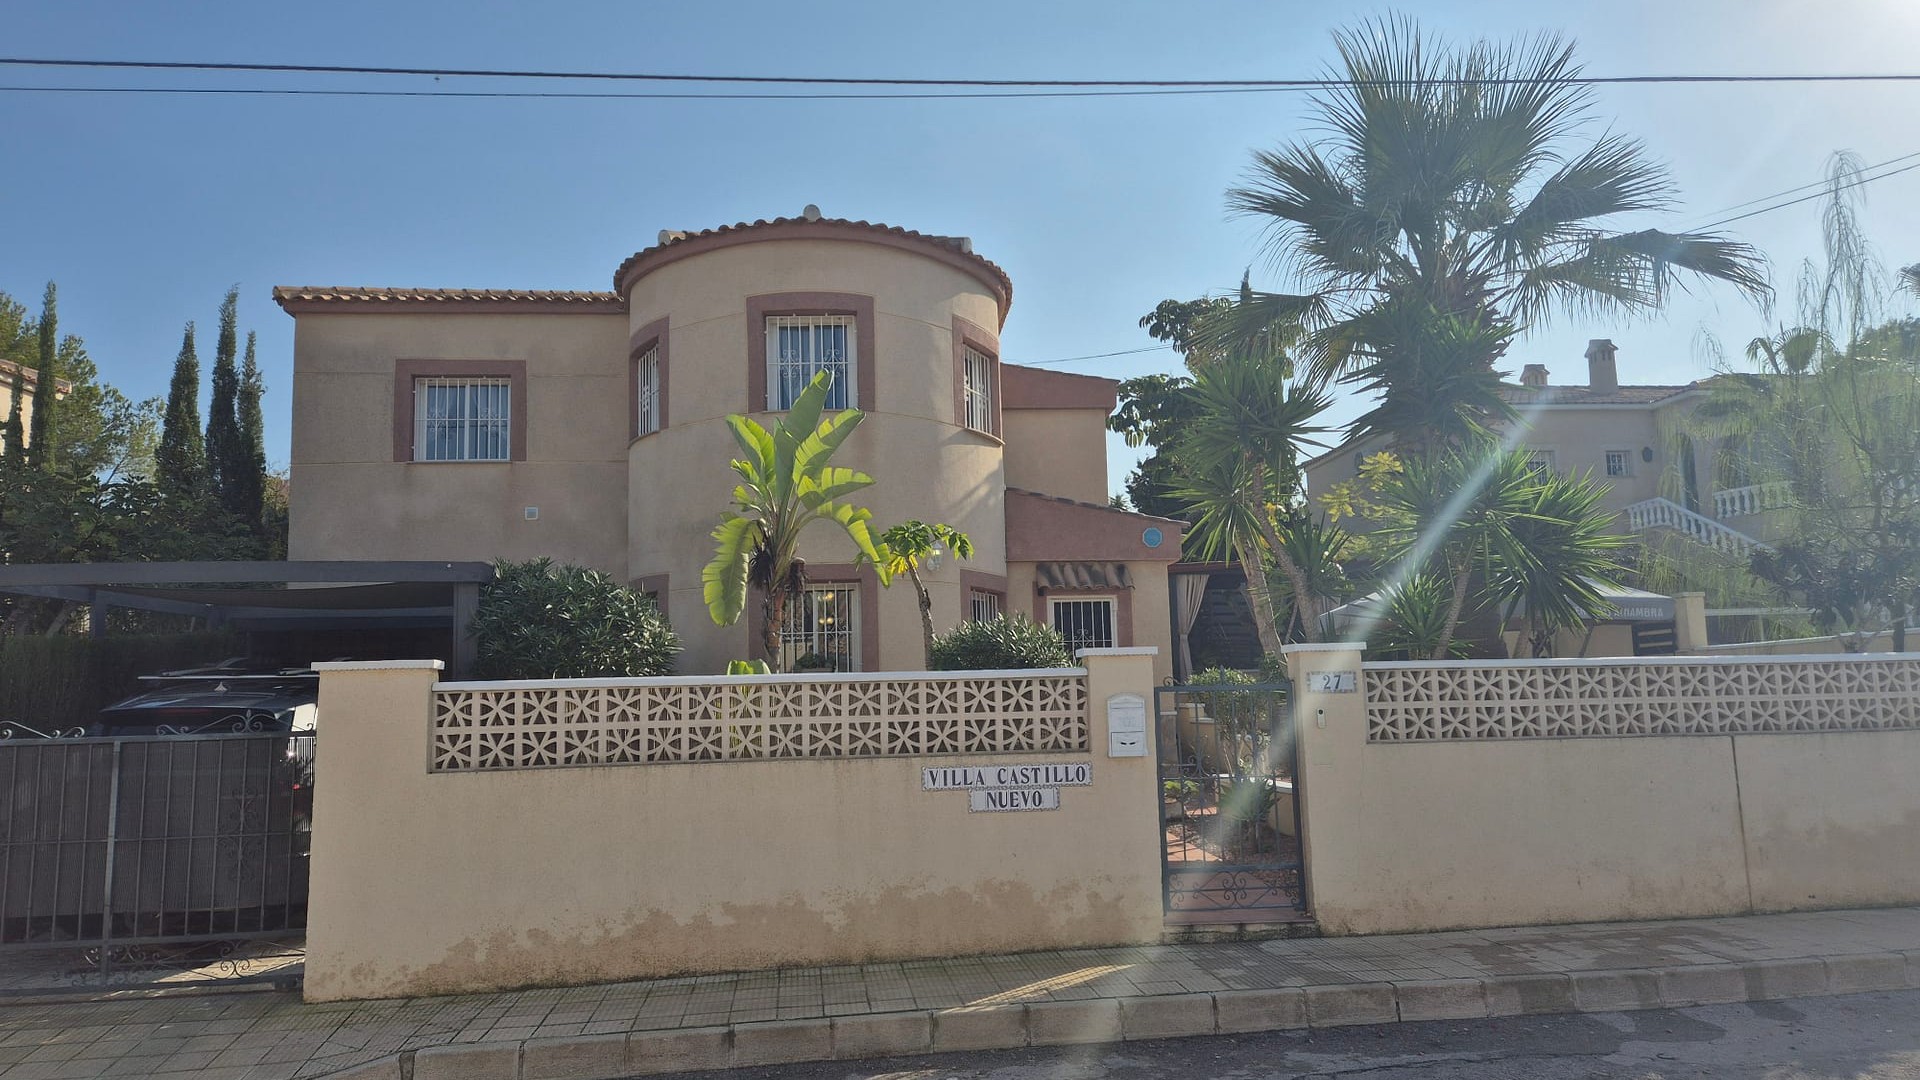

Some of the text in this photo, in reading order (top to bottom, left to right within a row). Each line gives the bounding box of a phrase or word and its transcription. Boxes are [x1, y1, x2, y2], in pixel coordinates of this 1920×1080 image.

[1322, 674, 1341, 690] 27
[929, 766, 1086, 787] VILLA CASTILLO
[986, 790, 1043, 809] NUEVO
